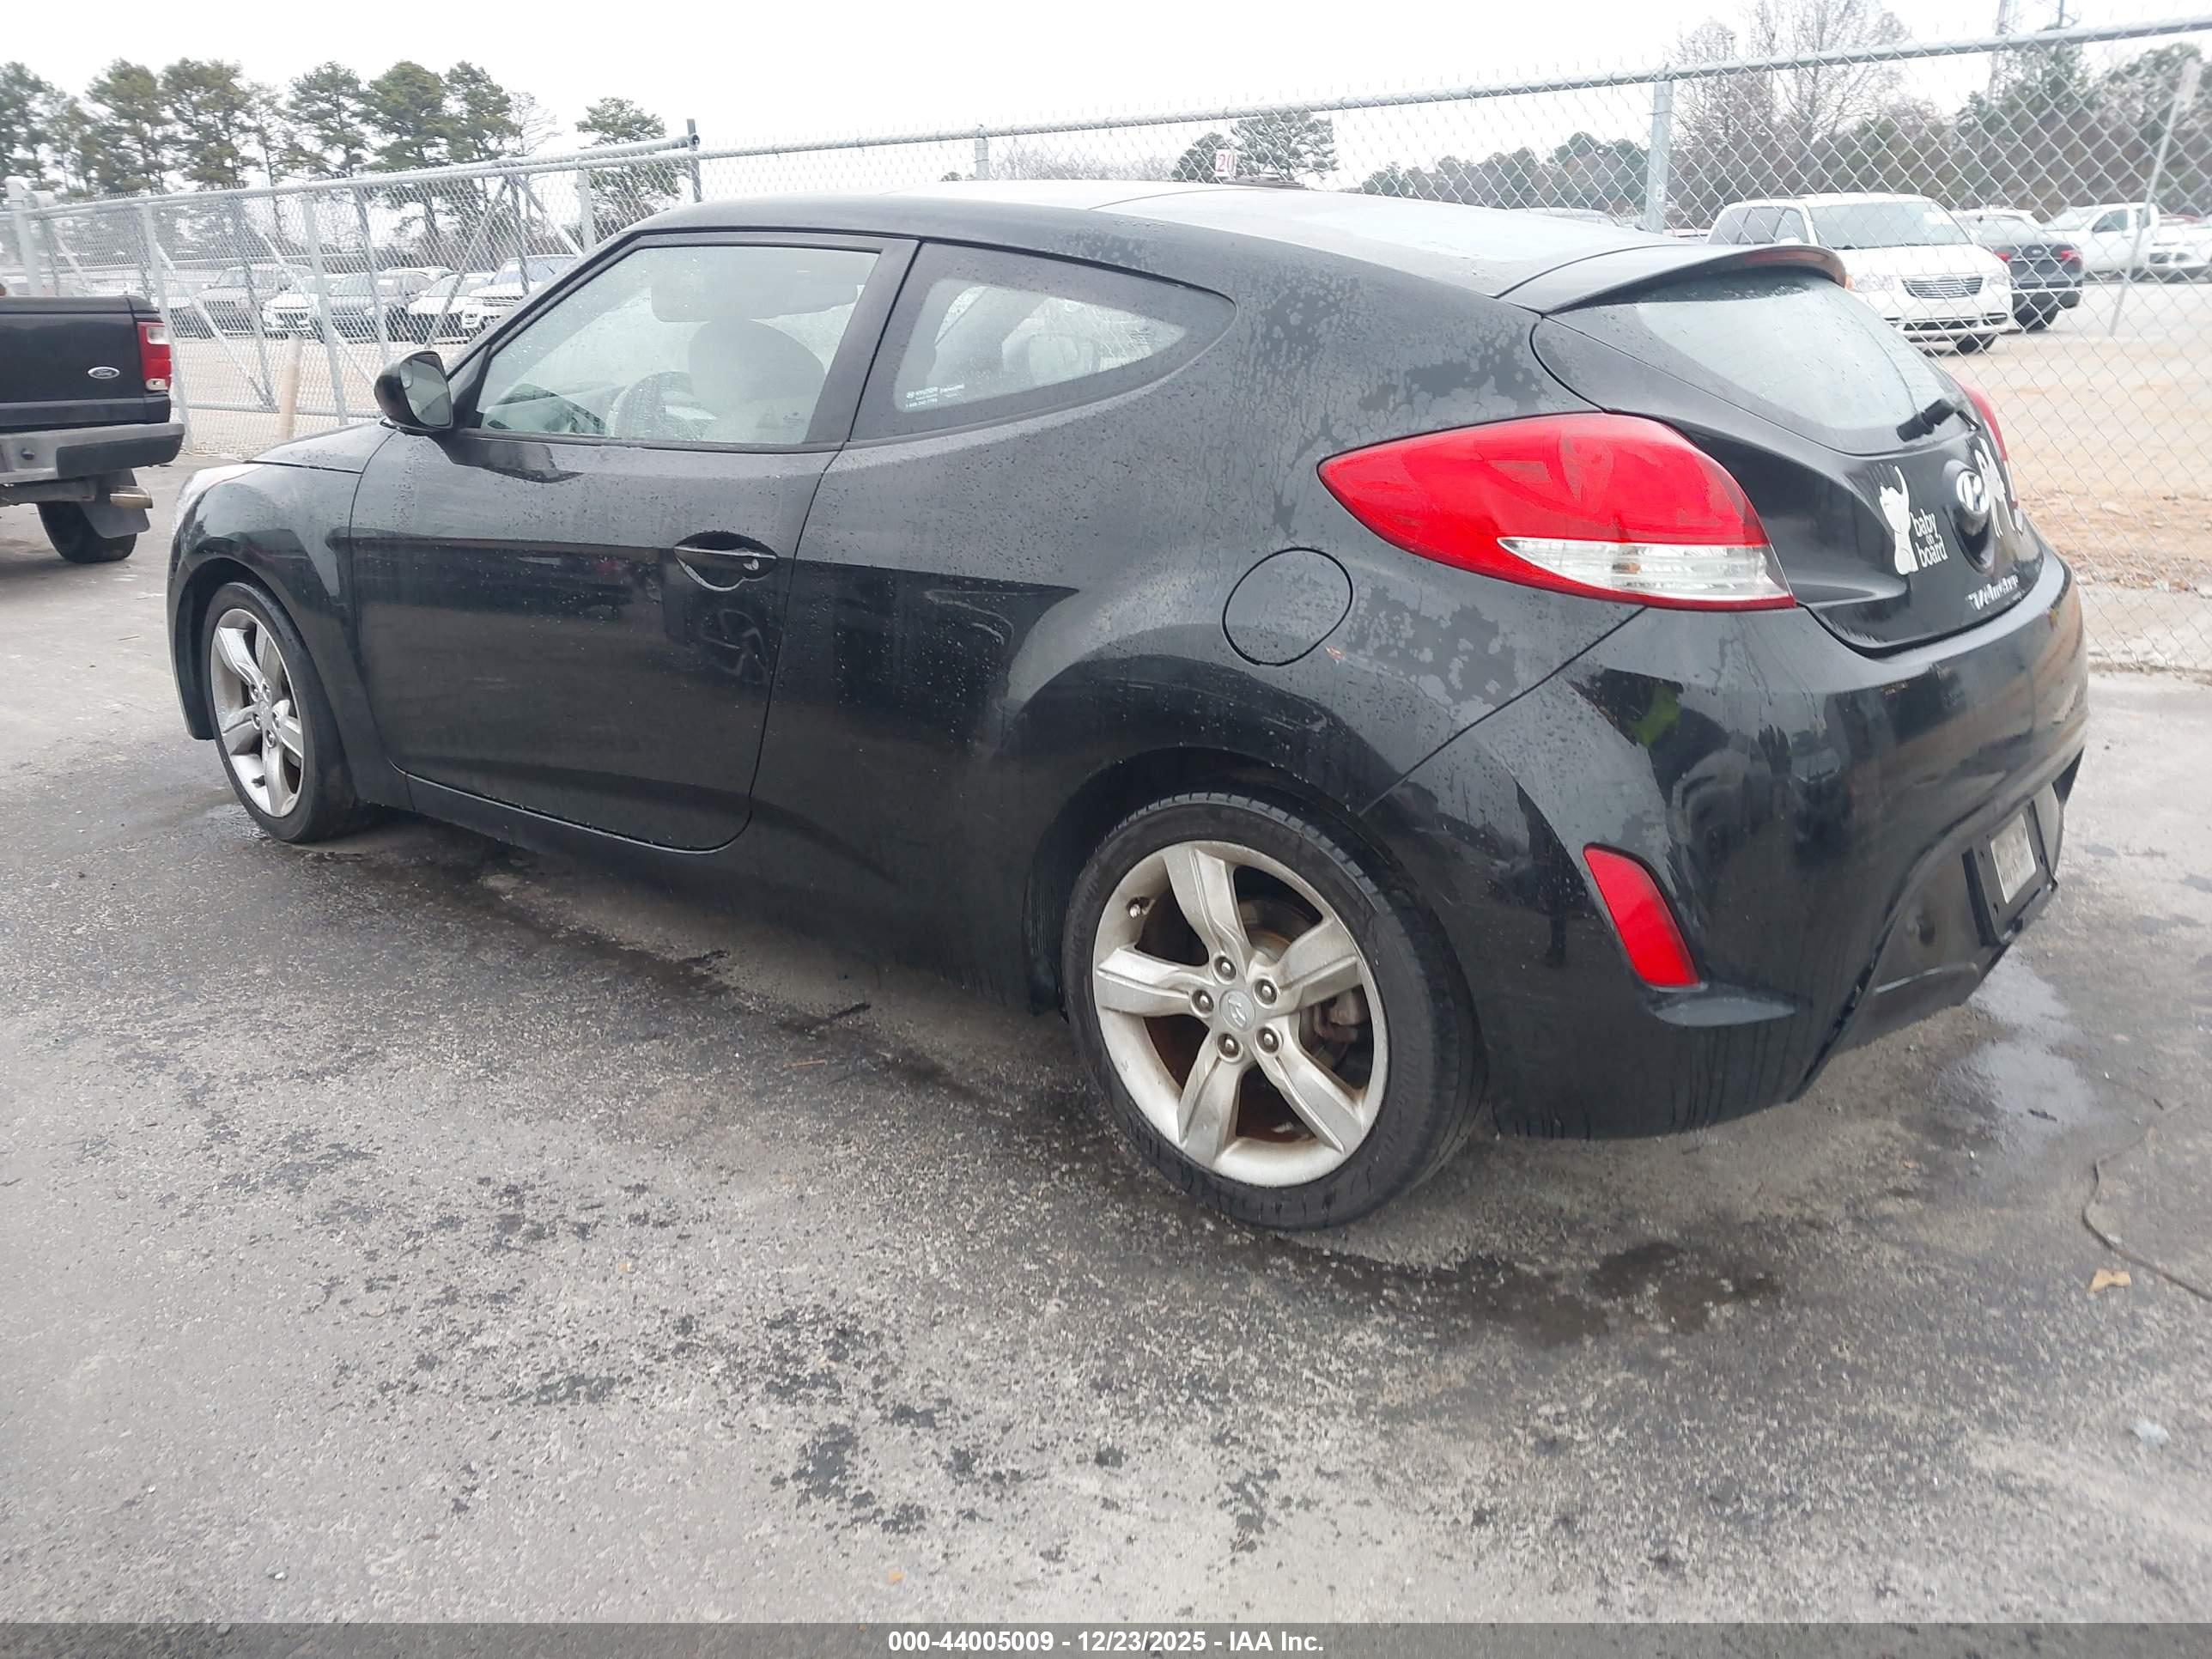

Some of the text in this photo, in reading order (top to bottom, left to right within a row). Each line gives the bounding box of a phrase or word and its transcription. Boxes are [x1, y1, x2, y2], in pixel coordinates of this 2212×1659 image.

[1909, 508, 1939, 538] baby
[1915, 534, 1948, 568] board
[1925, 534, 1936, 546] on
